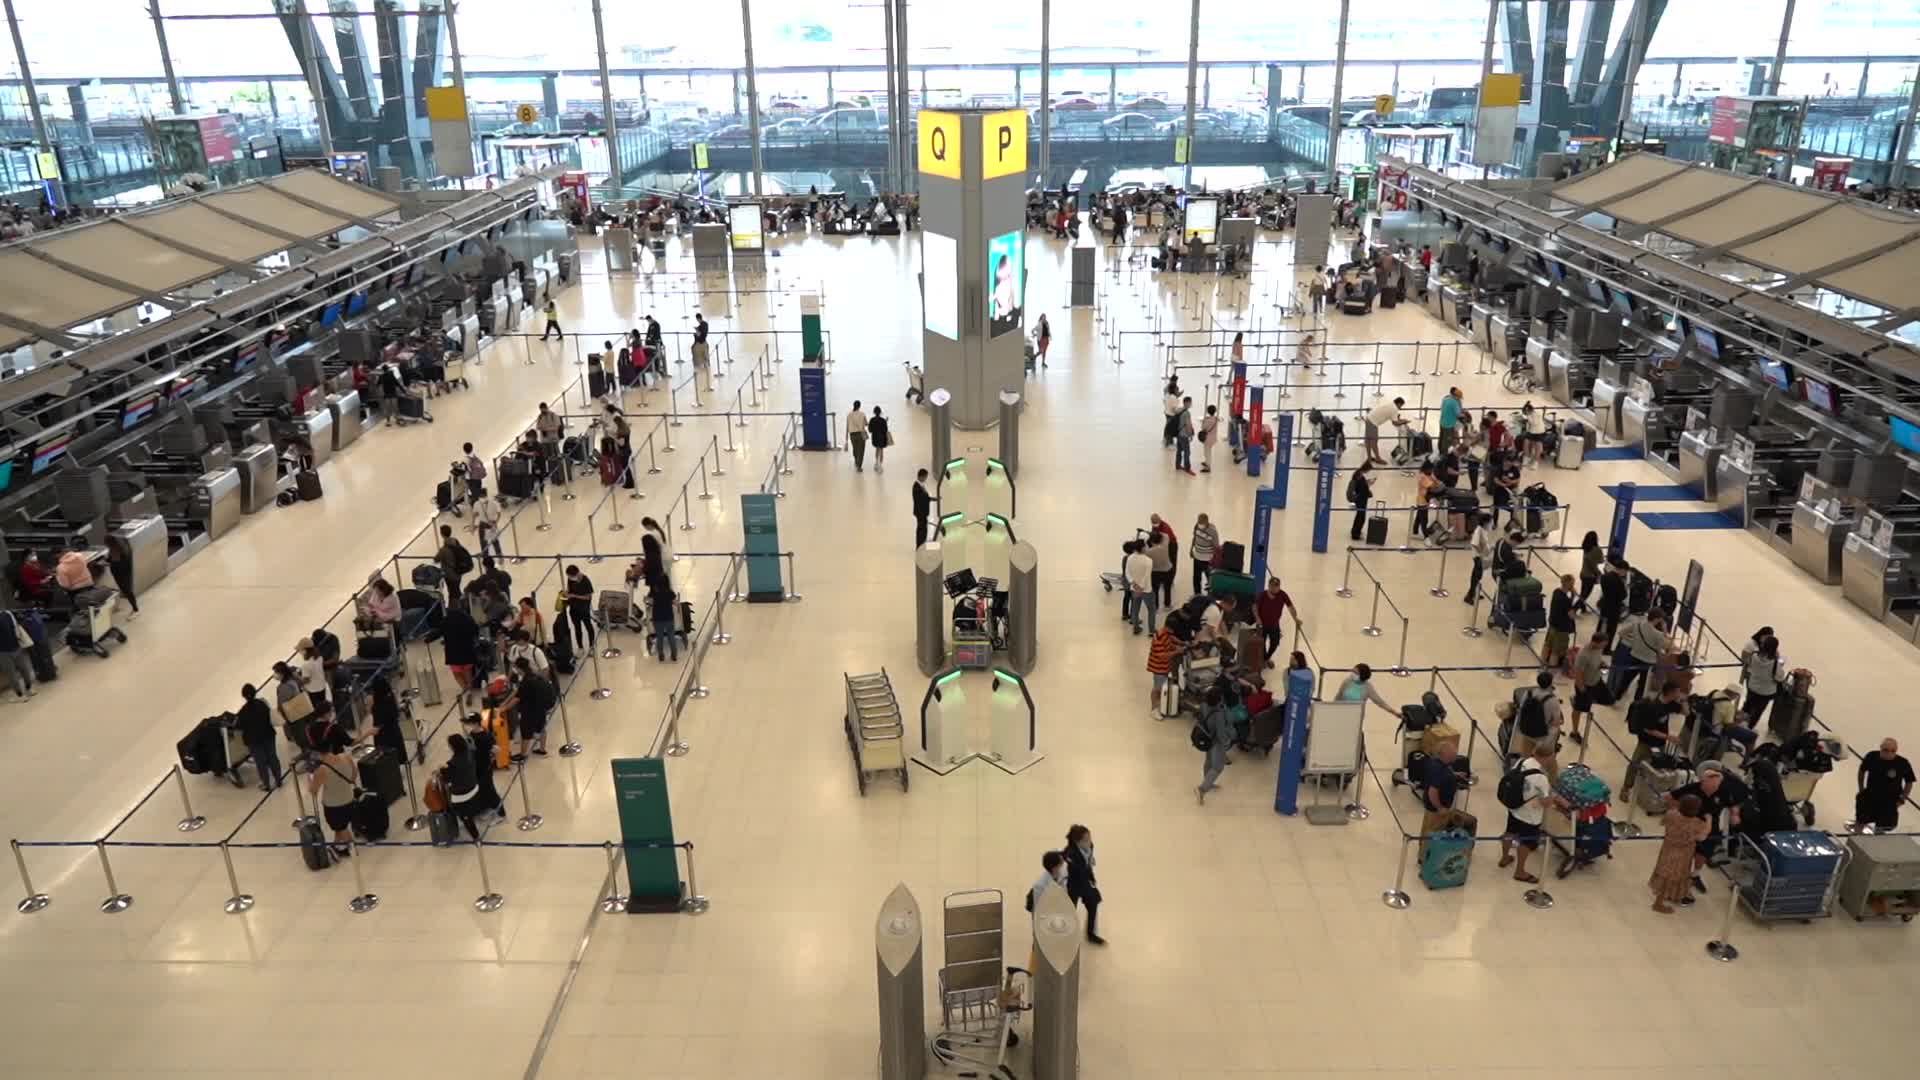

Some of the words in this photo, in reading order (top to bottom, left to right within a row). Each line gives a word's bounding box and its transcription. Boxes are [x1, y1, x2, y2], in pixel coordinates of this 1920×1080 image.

[522, 107, 532, 122] 8
[1380, 97, 1390, 112] 7
[931, 126, 946, 161] Q
[998, 125, 1012, 162] P
